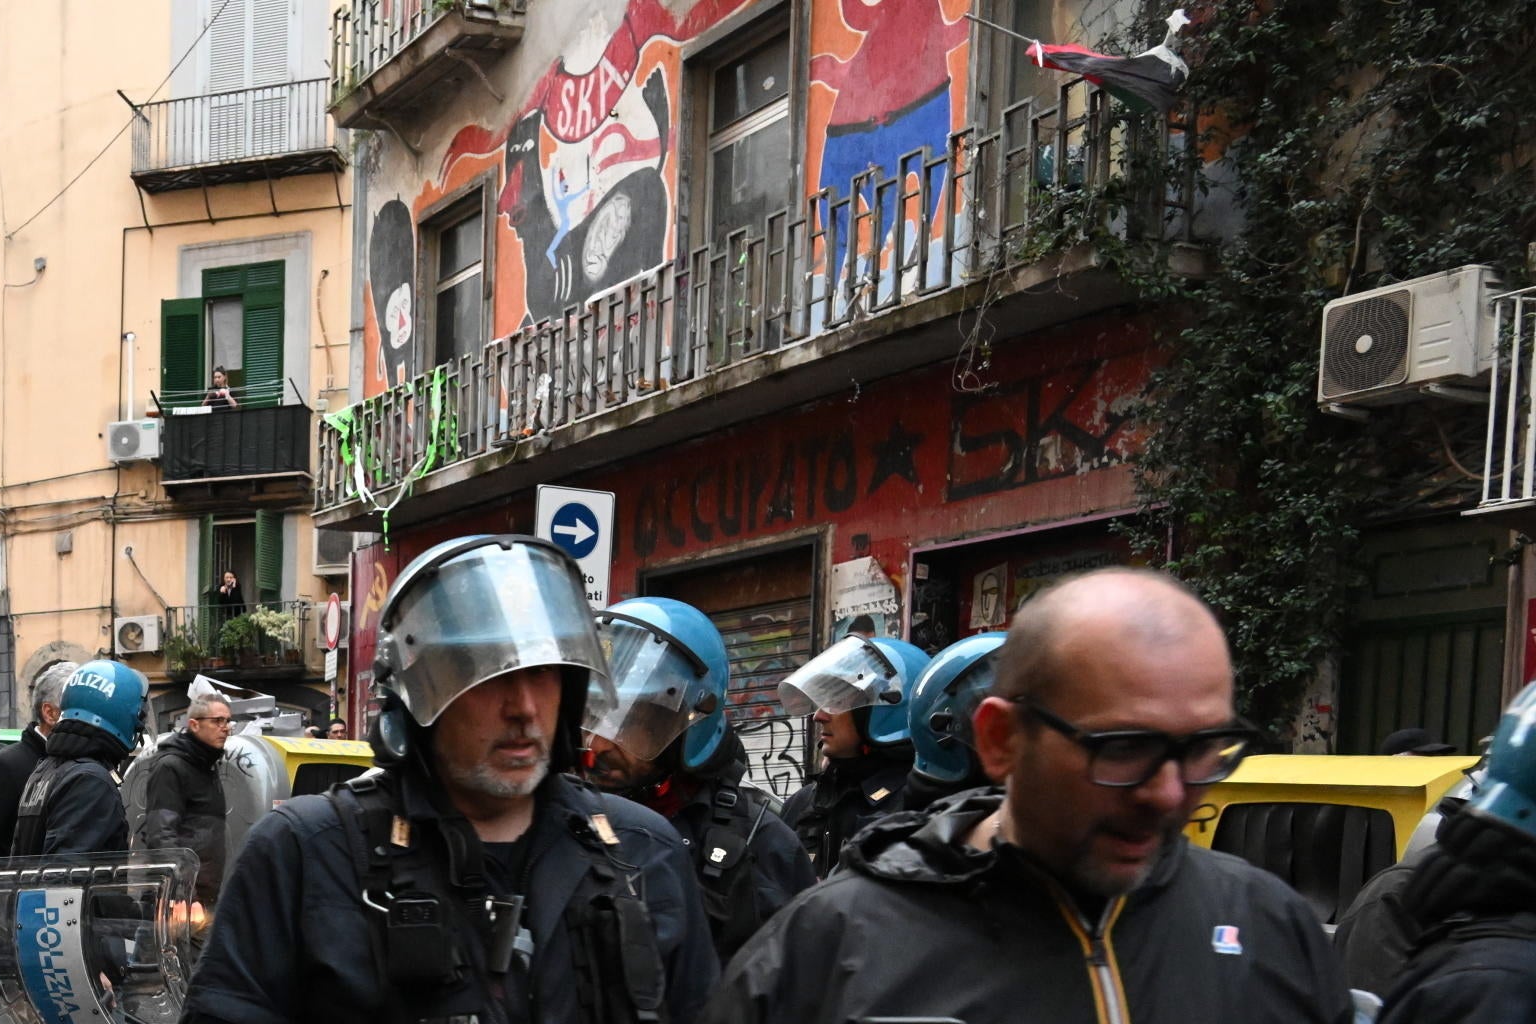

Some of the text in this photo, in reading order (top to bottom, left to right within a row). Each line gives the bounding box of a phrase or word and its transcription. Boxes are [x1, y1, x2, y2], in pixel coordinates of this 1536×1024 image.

[633, 358, 1140, 558] OCCUPATO SK
[34, 907, 81, 1018] POLIZIA
